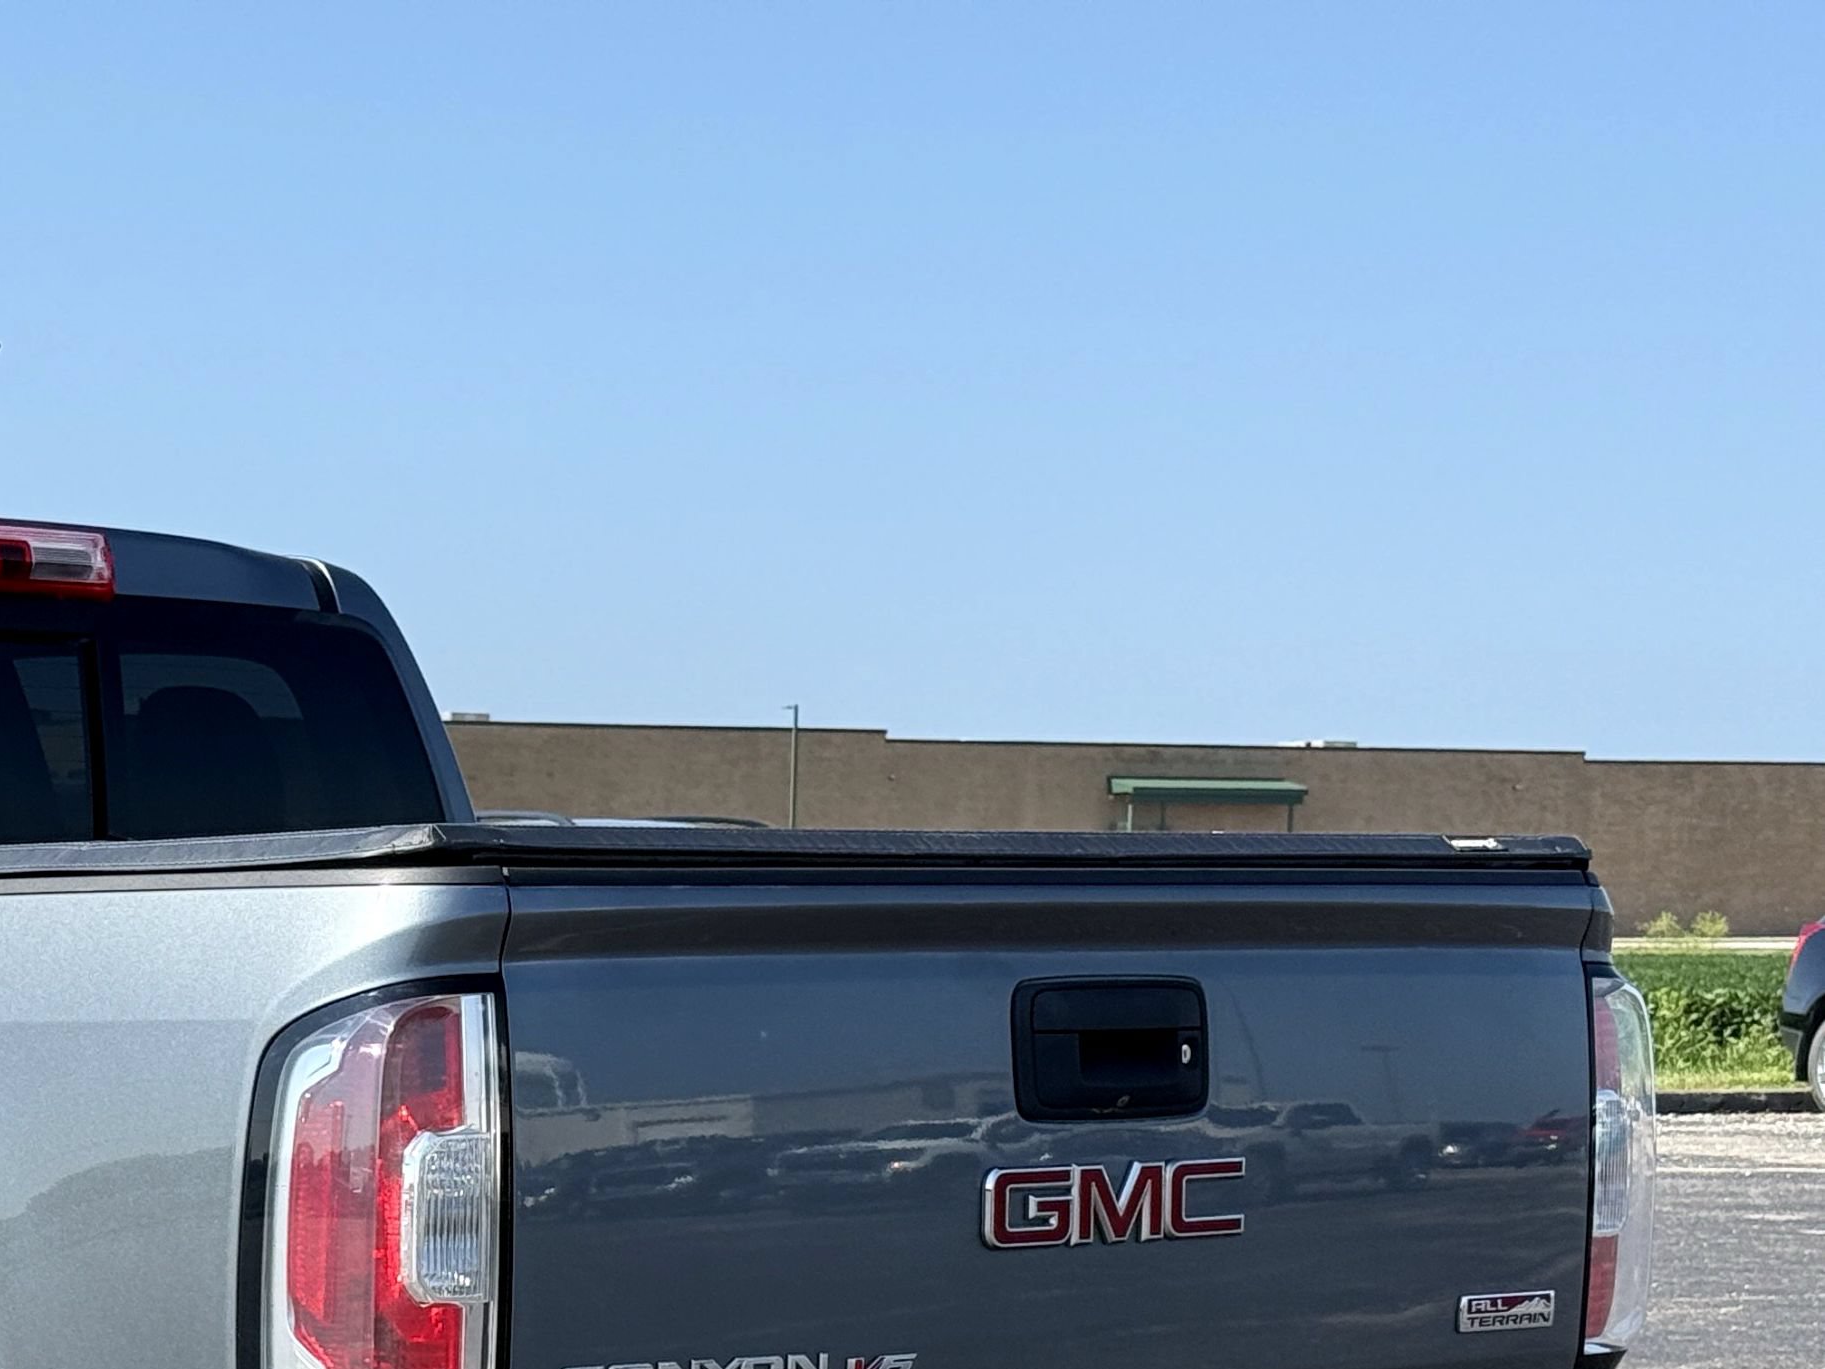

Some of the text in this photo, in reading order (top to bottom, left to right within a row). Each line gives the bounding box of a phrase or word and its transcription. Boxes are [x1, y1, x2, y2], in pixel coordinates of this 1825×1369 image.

[982, 1156, 1246, 1248] GMC
[1470, 1298, 1509, 1313] ALL
[1466, 1312, 1551, 1329] TERRAIN
